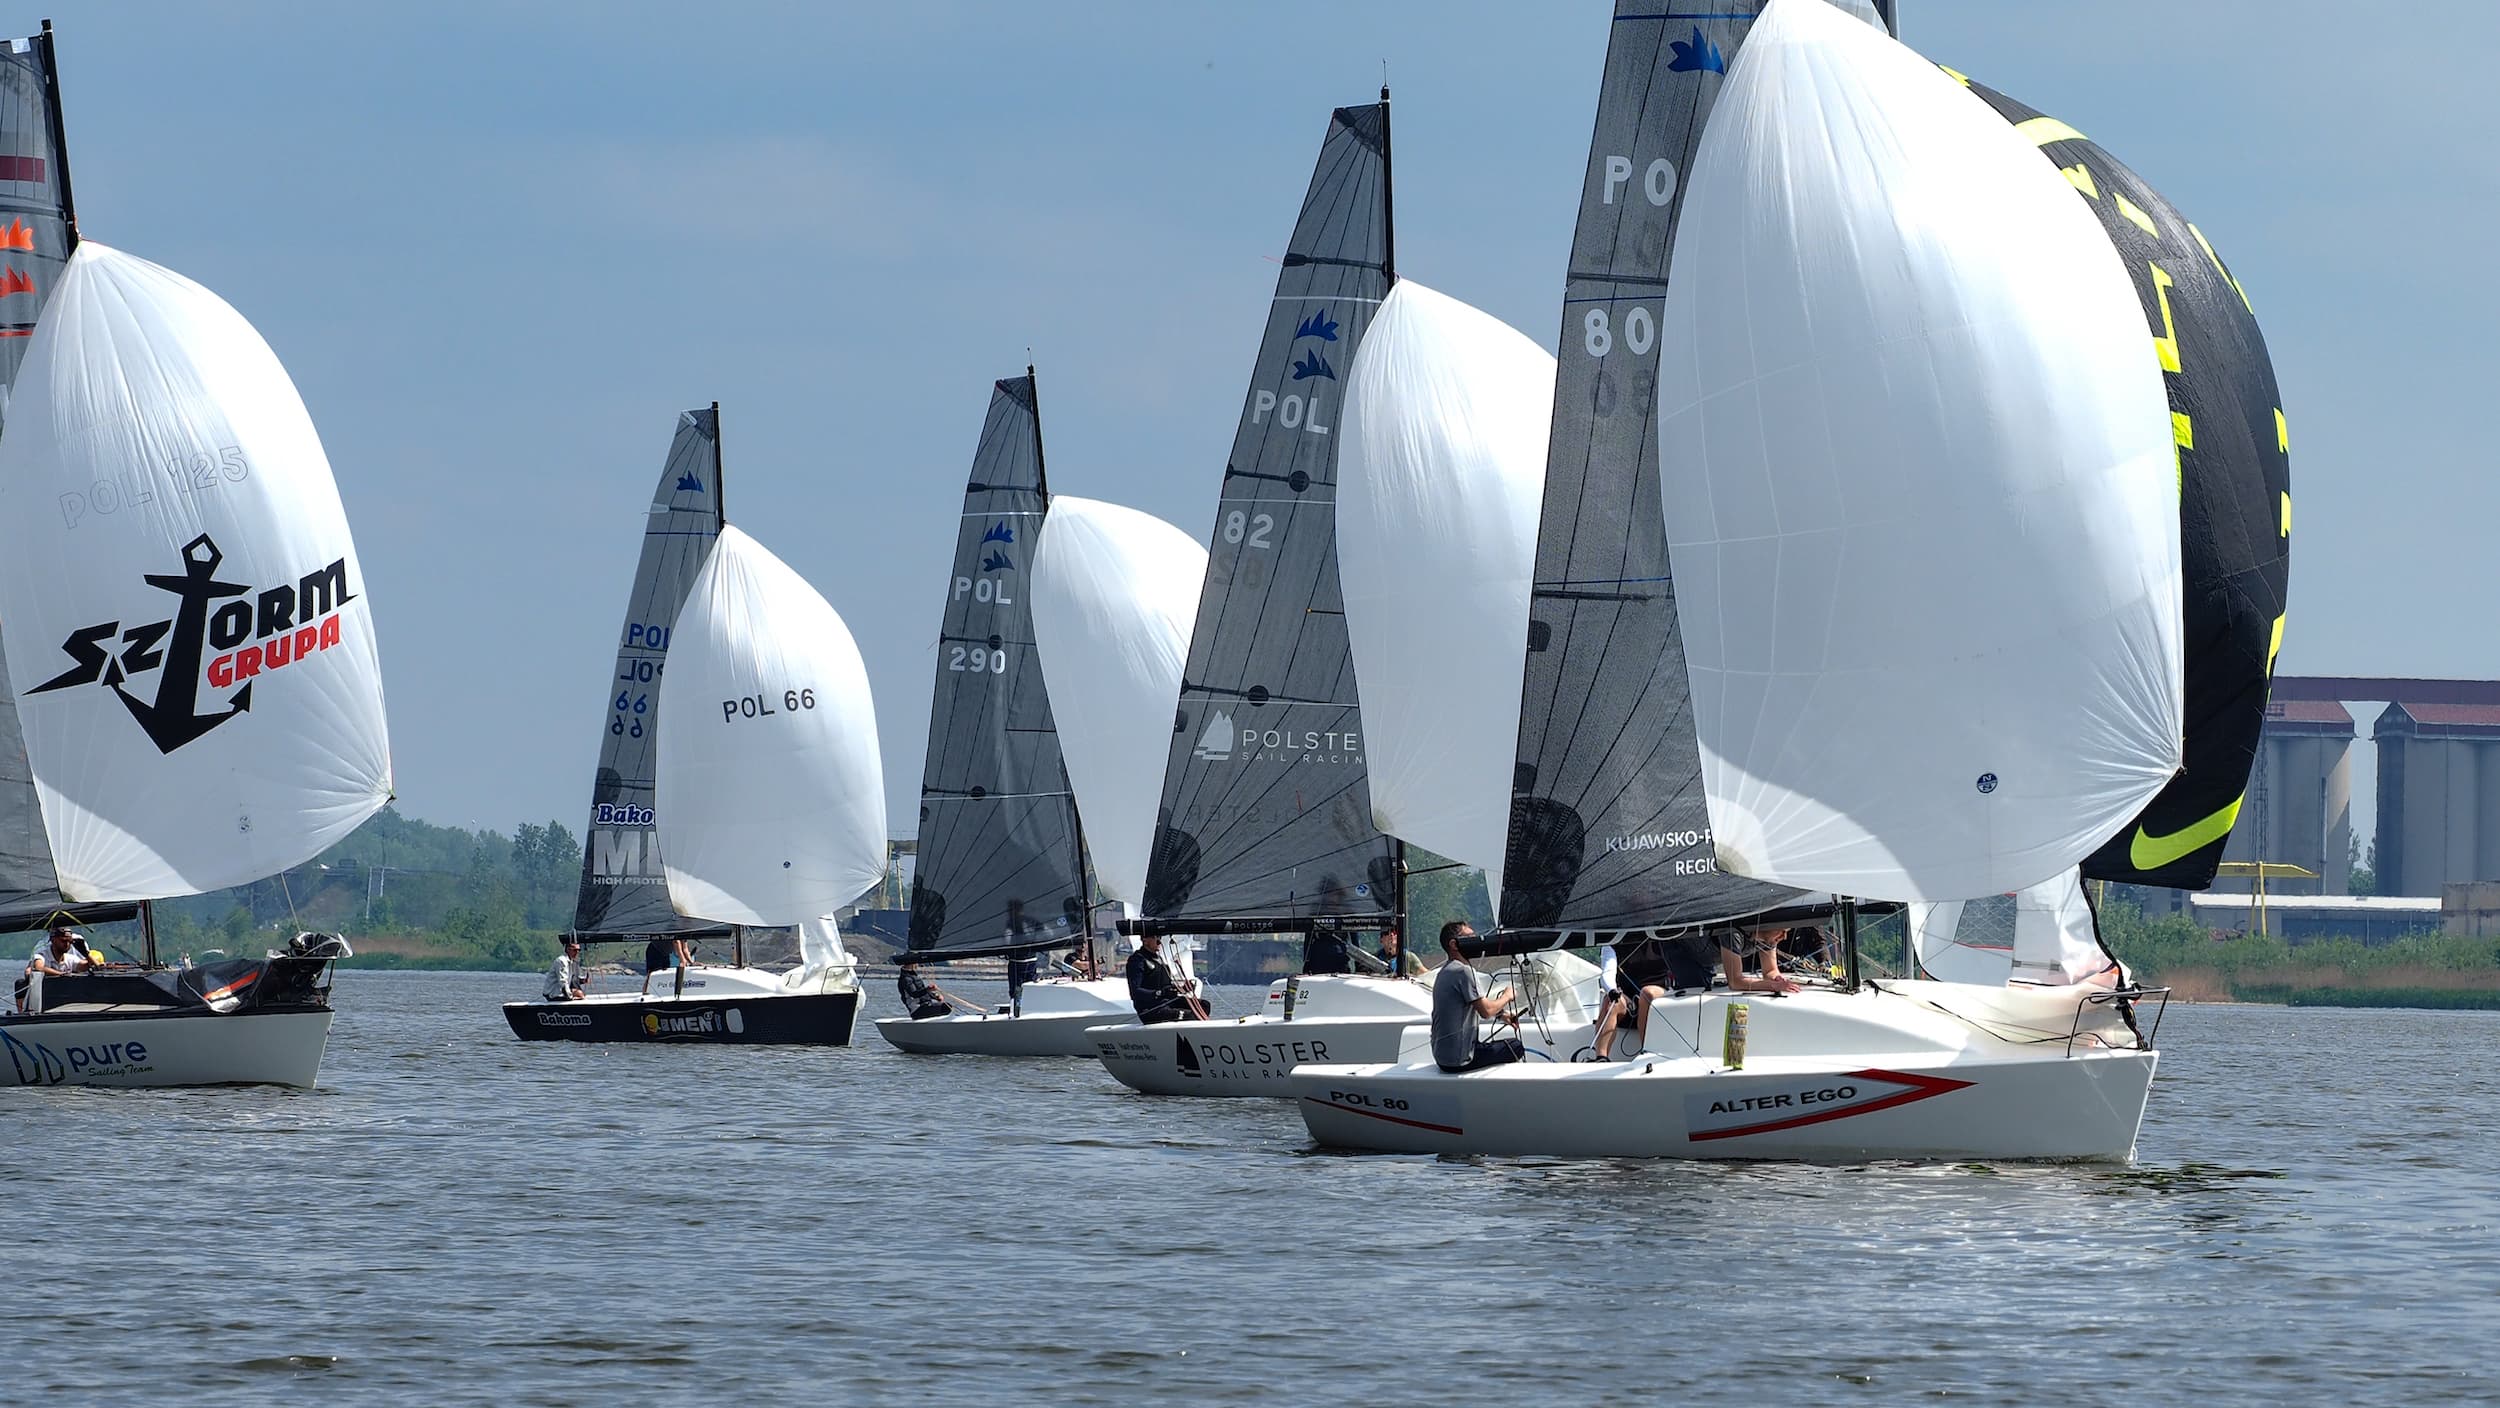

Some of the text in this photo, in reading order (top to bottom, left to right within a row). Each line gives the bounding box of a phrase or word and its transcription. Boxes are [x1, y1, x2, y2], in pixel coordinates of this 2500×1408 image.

[1584, 306, 1655, 357] 80
[1252, 389, 1328, 434] POL
[58, 445, 249, 530] POL 125
[1223, 510, 1274, 549] 82
[954, 576, 1011, 605] POL
[207, 613, 340, 688] GRUPA
[949, 646, 1007, 674] 290
[615, 690, 647, 714] 66
[722, 688, 816, 723] POL 66
[1242, 730, 1357, 751] POLSTE
[1242, 751, 1287, 763] SAIL
[593, 877, 622, 885] HIGH
[537, 1012, 592, 1026] Bakoma
[65, 1042, 148, 1073] pure
[1200, 1040, 1330, 1065] POLSTER
[1210, 1069, 1250, 1079] SAIL
[1331, 1091, 1410, 1112] POL 80
[1709, 1086, 1858, 1115] ALTER EGO
